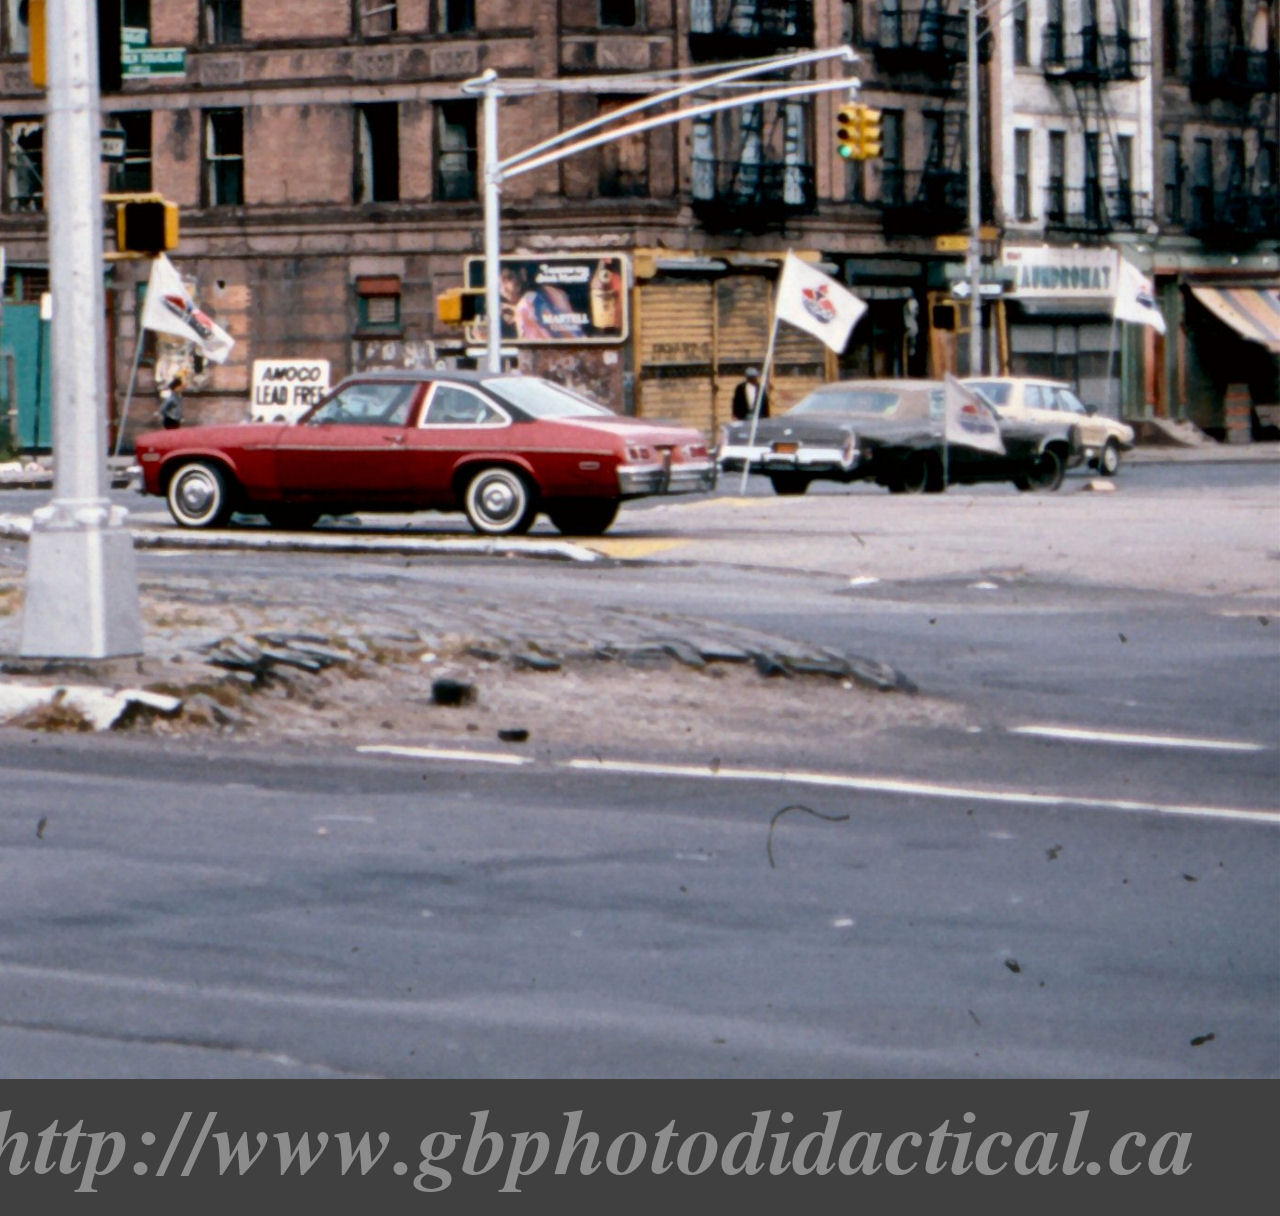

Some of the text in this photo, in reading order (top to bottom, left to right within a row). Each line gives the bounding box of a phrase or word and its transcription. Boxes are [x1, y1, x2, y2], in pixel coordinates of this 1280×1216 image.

[1019, 265, 1112, 290] AUNDROMAT
[262, 366, 322, 382] AMOCO
[255, 385, 288, 406] LEAD
